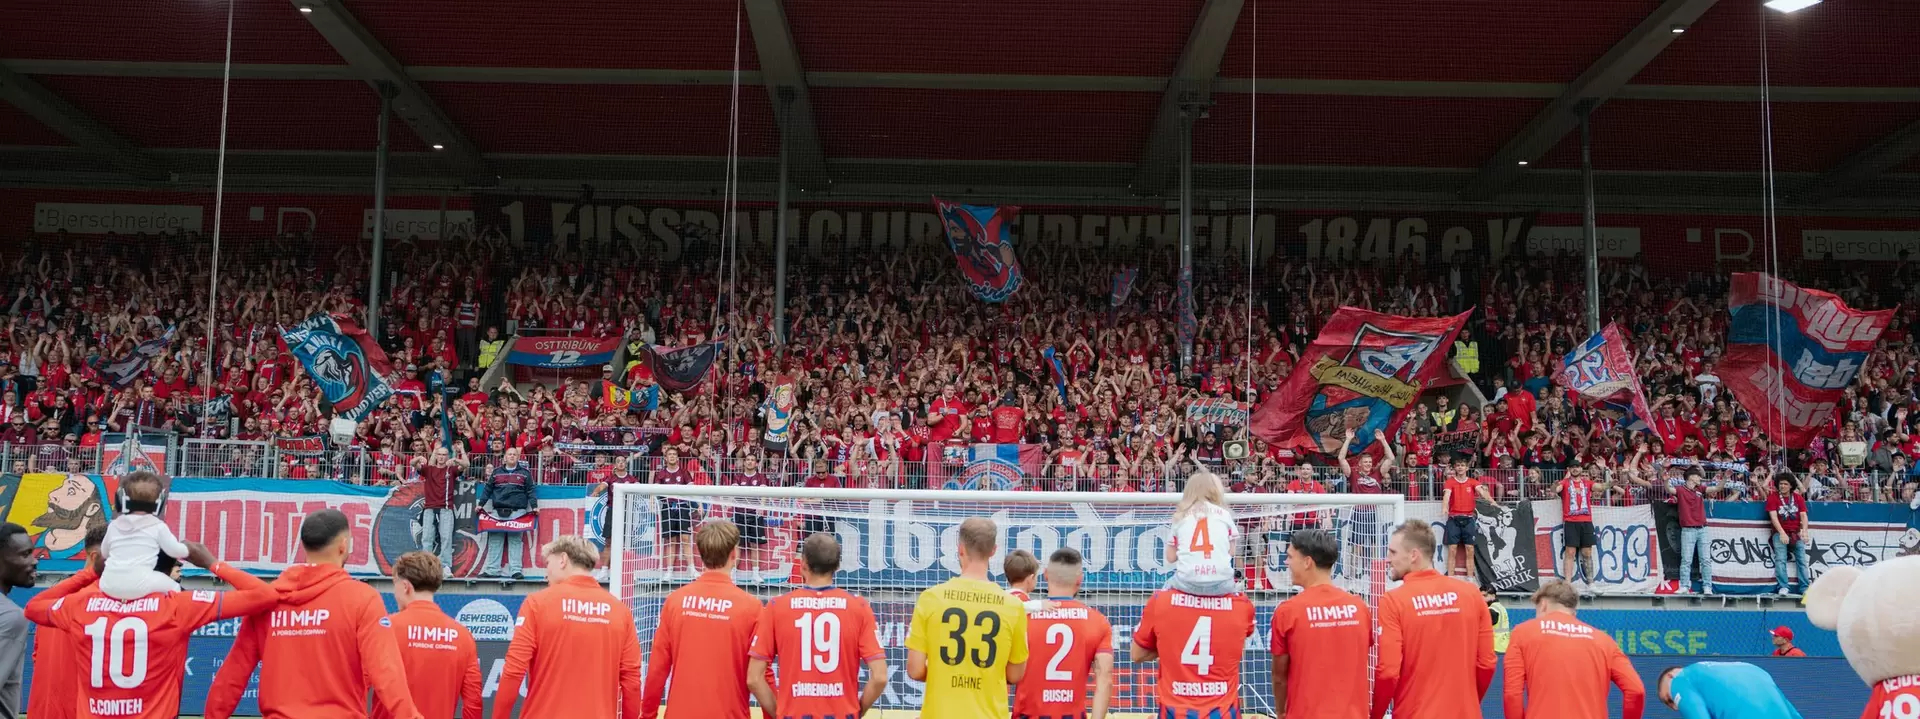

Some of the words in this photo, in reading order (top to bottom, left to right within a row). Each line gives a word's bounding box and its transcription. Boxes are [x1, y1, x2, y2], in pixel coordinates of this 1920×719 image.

[47, 208, 190, 230] Bierschneider
[1299, 216, 1428, 263] 1846
[535, 338, 602, 351] OSTTRIBÜNE
[549, 350, 582, 364] 12
[1190, 516, 1214, 559] 4
[1194, 565, 1217, 575] PAPA
[86, 597, 159, 613] HEIDENHEIM
[698, 597, 733, 612] MHP
[790, 596, 847, 611] HEIDENHEIM
[943, 589, 1005, 606] HEIDENHEIM
[1171, 593, 1233, 611] HEIDENHEIM
[1427, 592, 1458, 607] MHP
[577, 601, 611, 616] MHP
[1030, 607, 1088, 620] HEIDENHEIM
[1324, 605, 1358, 619] MHP
[290, 609, 330, 627] MHP
[459, 613, 509, 623] BEWERBEN
[423, 625, 459, 642] MHP
[465, 625, 509, 635] EWERBEN
[1557, 621, 1594, 634] MHP
[795, 612, 841, 673] 19
[939, 607, 1001, 669] 33
[1180, 615, 1214, 676] 4
[84, 616, 149, 689] 10
[1045, 623, 1074, 681] 2
[951, 674, 982, 690] DÄHNE
[1172, 681, 1228, 697] SIERSLEBEN
[1042, 688, 1074, 703] BUSCH
[89, 698, 143, 716] C.CONTEH
